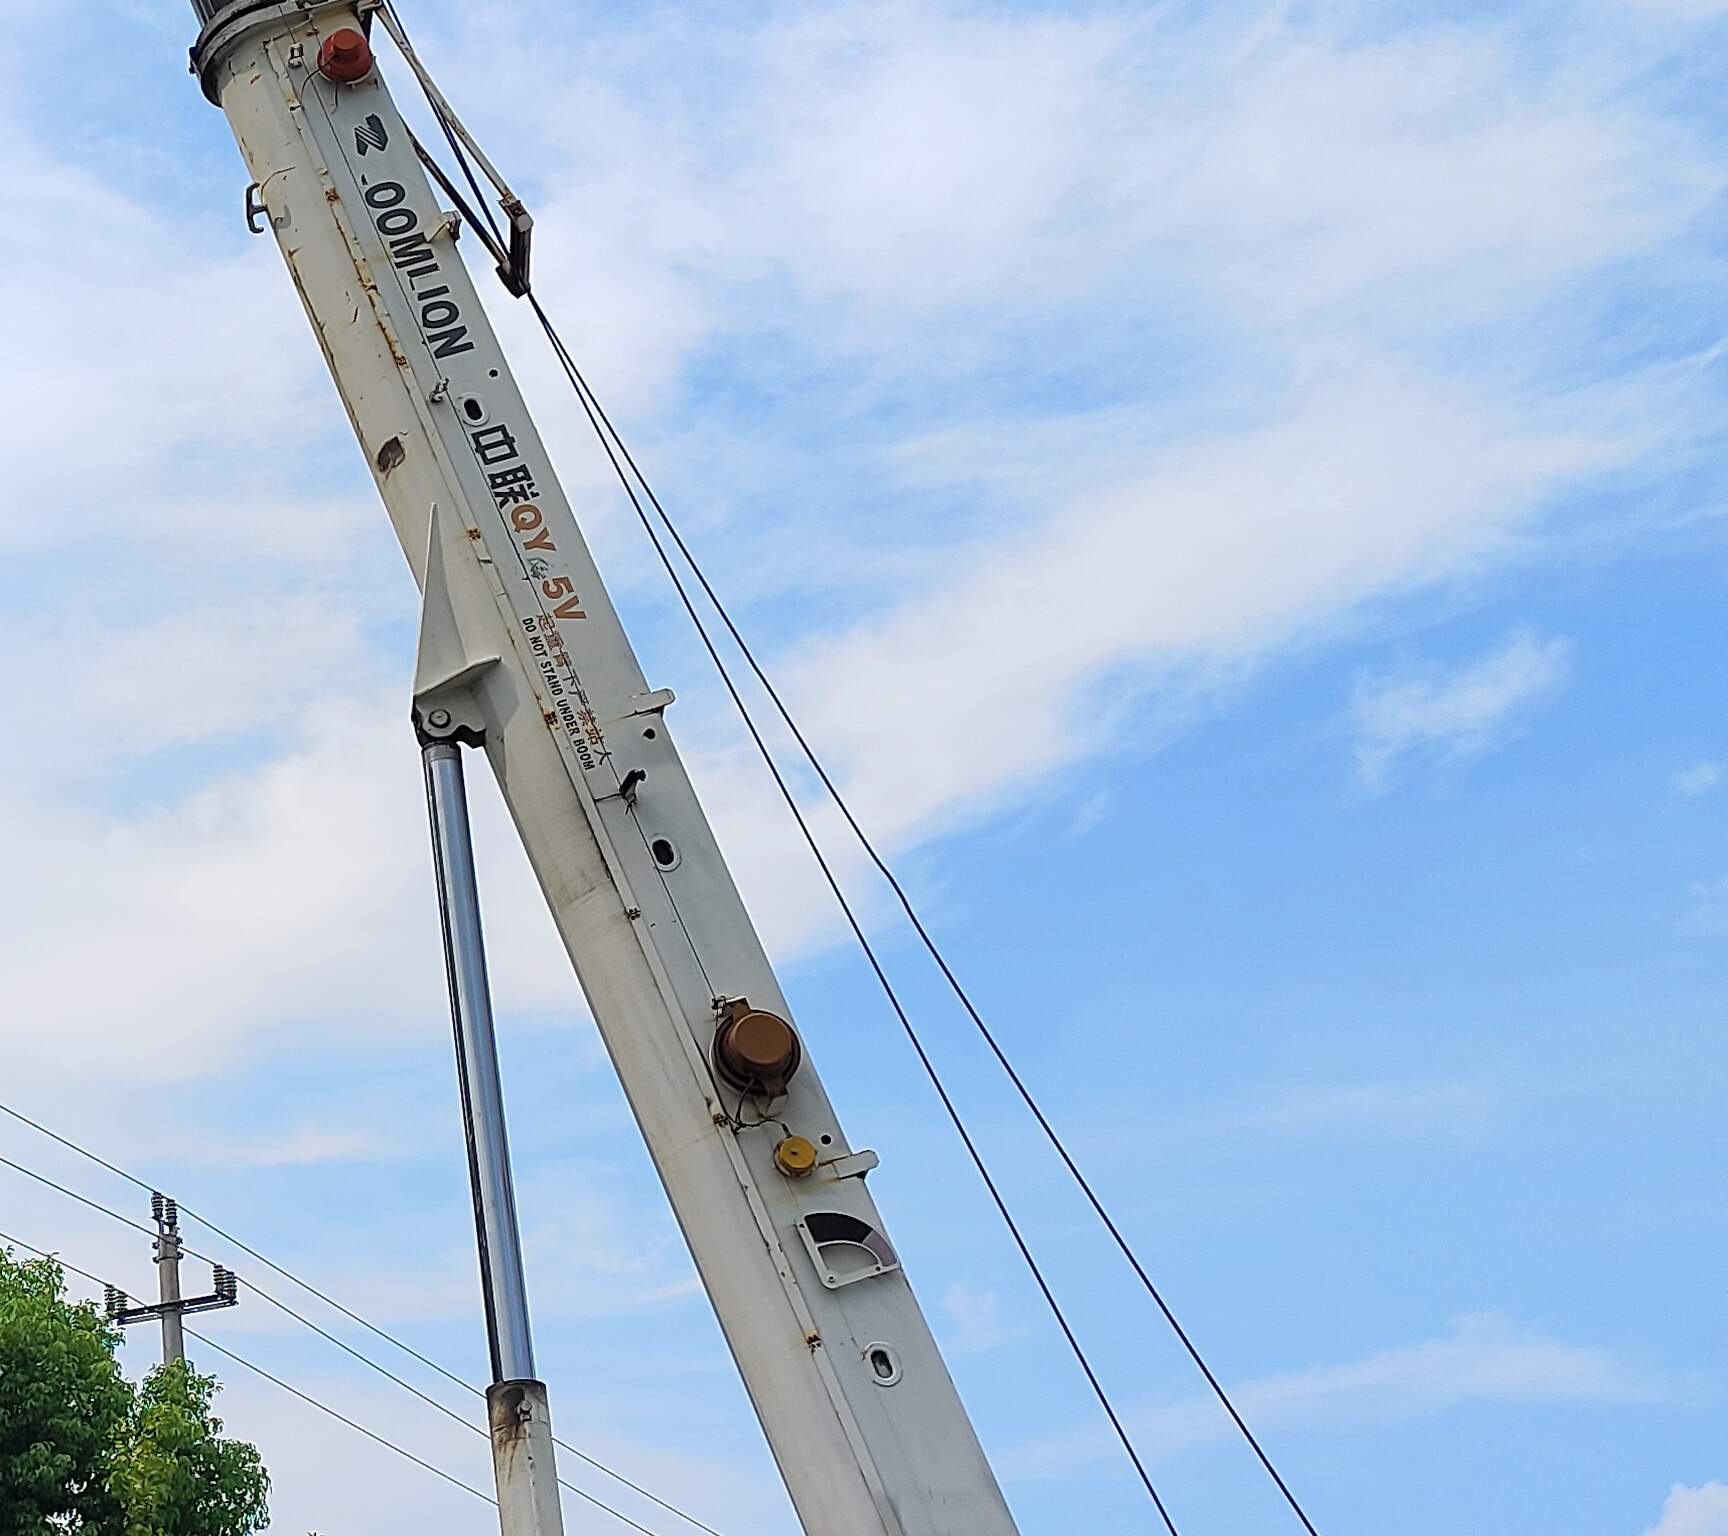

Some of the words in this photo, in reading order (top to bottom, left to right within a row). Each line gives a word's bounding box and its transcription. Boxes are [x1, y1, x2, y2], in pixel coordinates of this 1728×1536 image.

[362, 176, 475, 360] OOMLION
[511, 504, 587, 619] QY5V
[522, 617, 537, 633] DO
[529, 636, 548, 658] NOT
[540, 660, 563, 696] STAND
[556, 698, 580, 737] UNDER
[573, 738, 596, 771] BOOM
